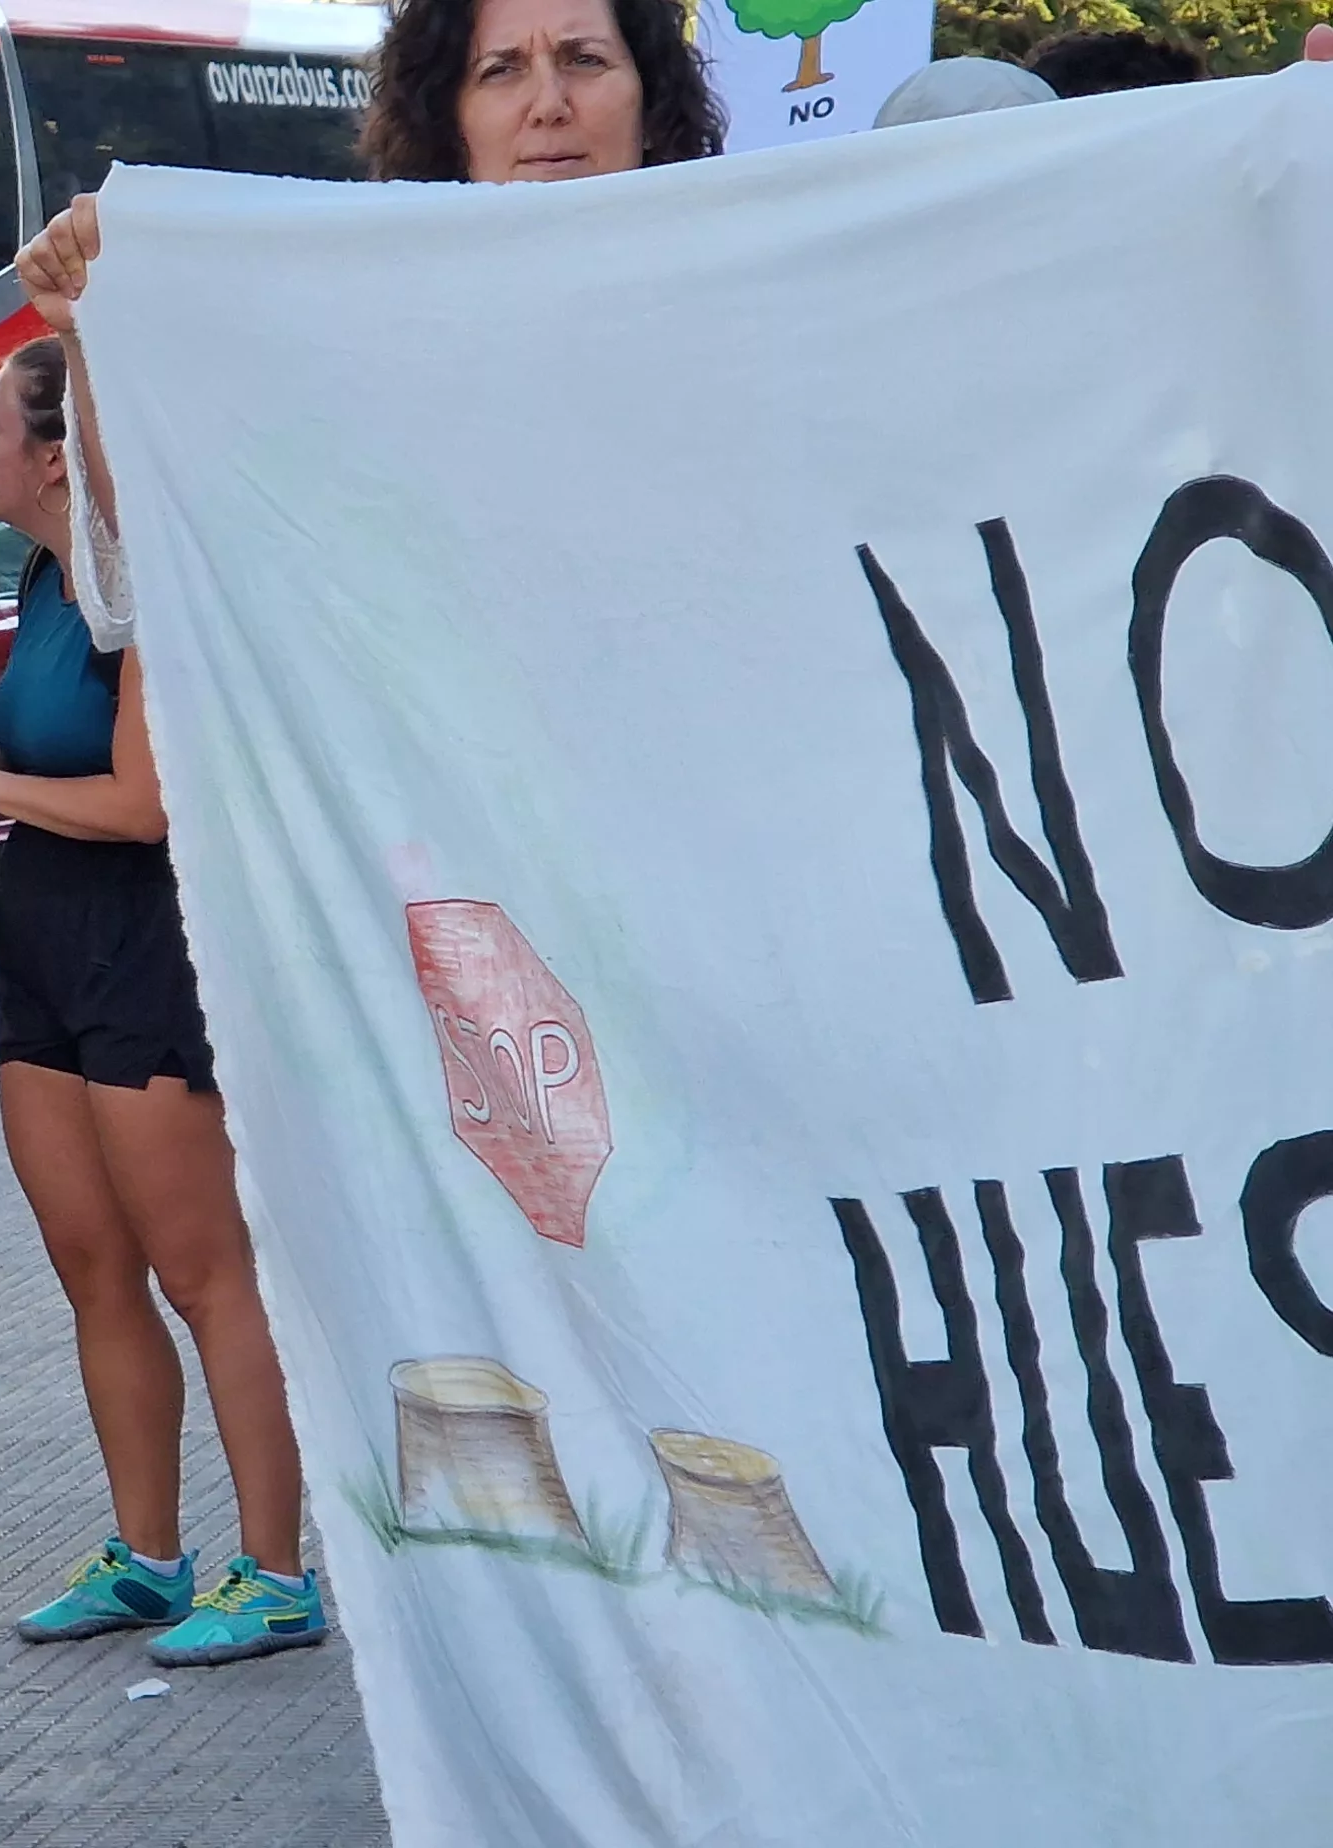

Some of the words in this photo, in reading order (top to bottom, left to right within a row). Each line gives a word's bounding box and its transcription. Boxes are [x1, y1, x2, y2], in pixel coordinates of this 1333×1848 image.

[788, 96, 835, 127] NO
[854, 474, 1333, 1005] NO
[434, 1003, 581, 1145] SOP
